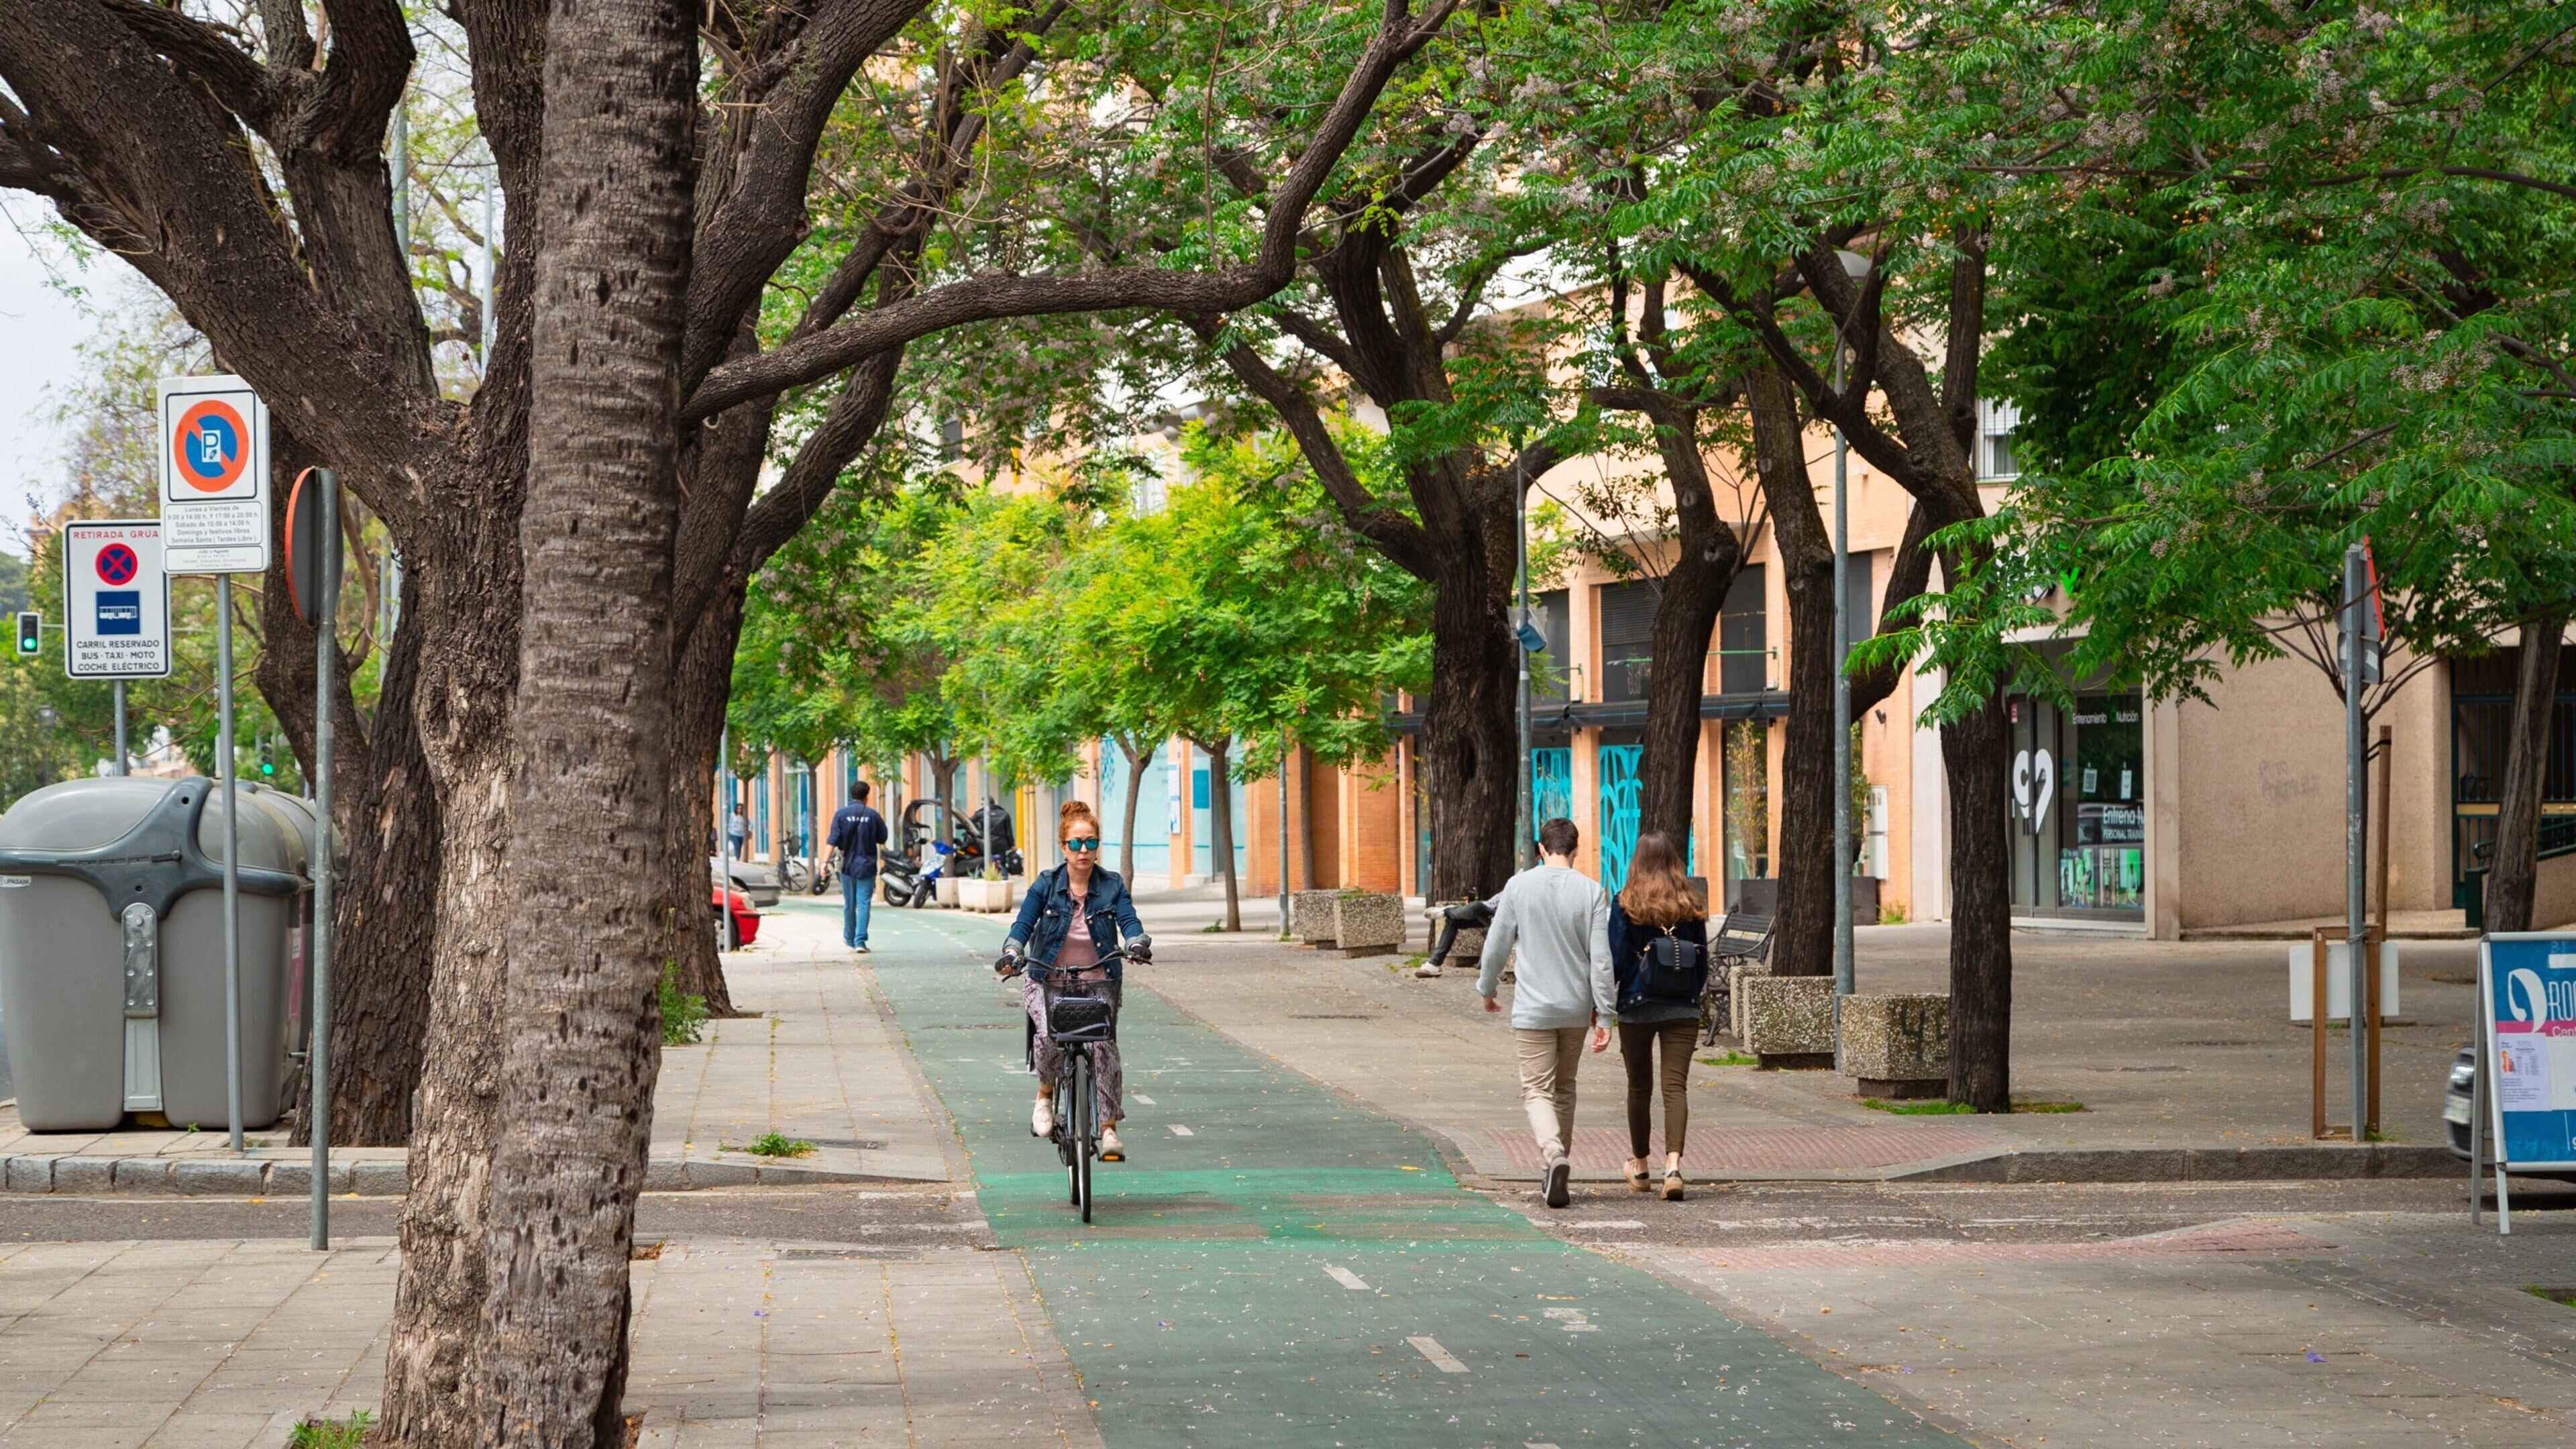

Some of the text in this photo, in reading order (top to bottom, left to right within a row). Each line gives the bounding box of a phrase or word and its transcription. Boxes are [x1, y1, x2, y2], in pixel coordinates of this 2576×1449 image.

[203, 433, 219, 458] P
[73, 529, 159, 539] RETIRADA GRÚA
[76, 639, 160, 649] CARRIL RESERVADO
[82, 652, 99, 660] BUS
[105, 651, 123, 659] TAXI
[131, 651, 155, 659] MOTO
[78, 661, 159, 671] COCHE ELÉCTRICO
[2103, 805, 2135, 824] Entrena
[2103, 828, 2127, 839] PERSONAL
